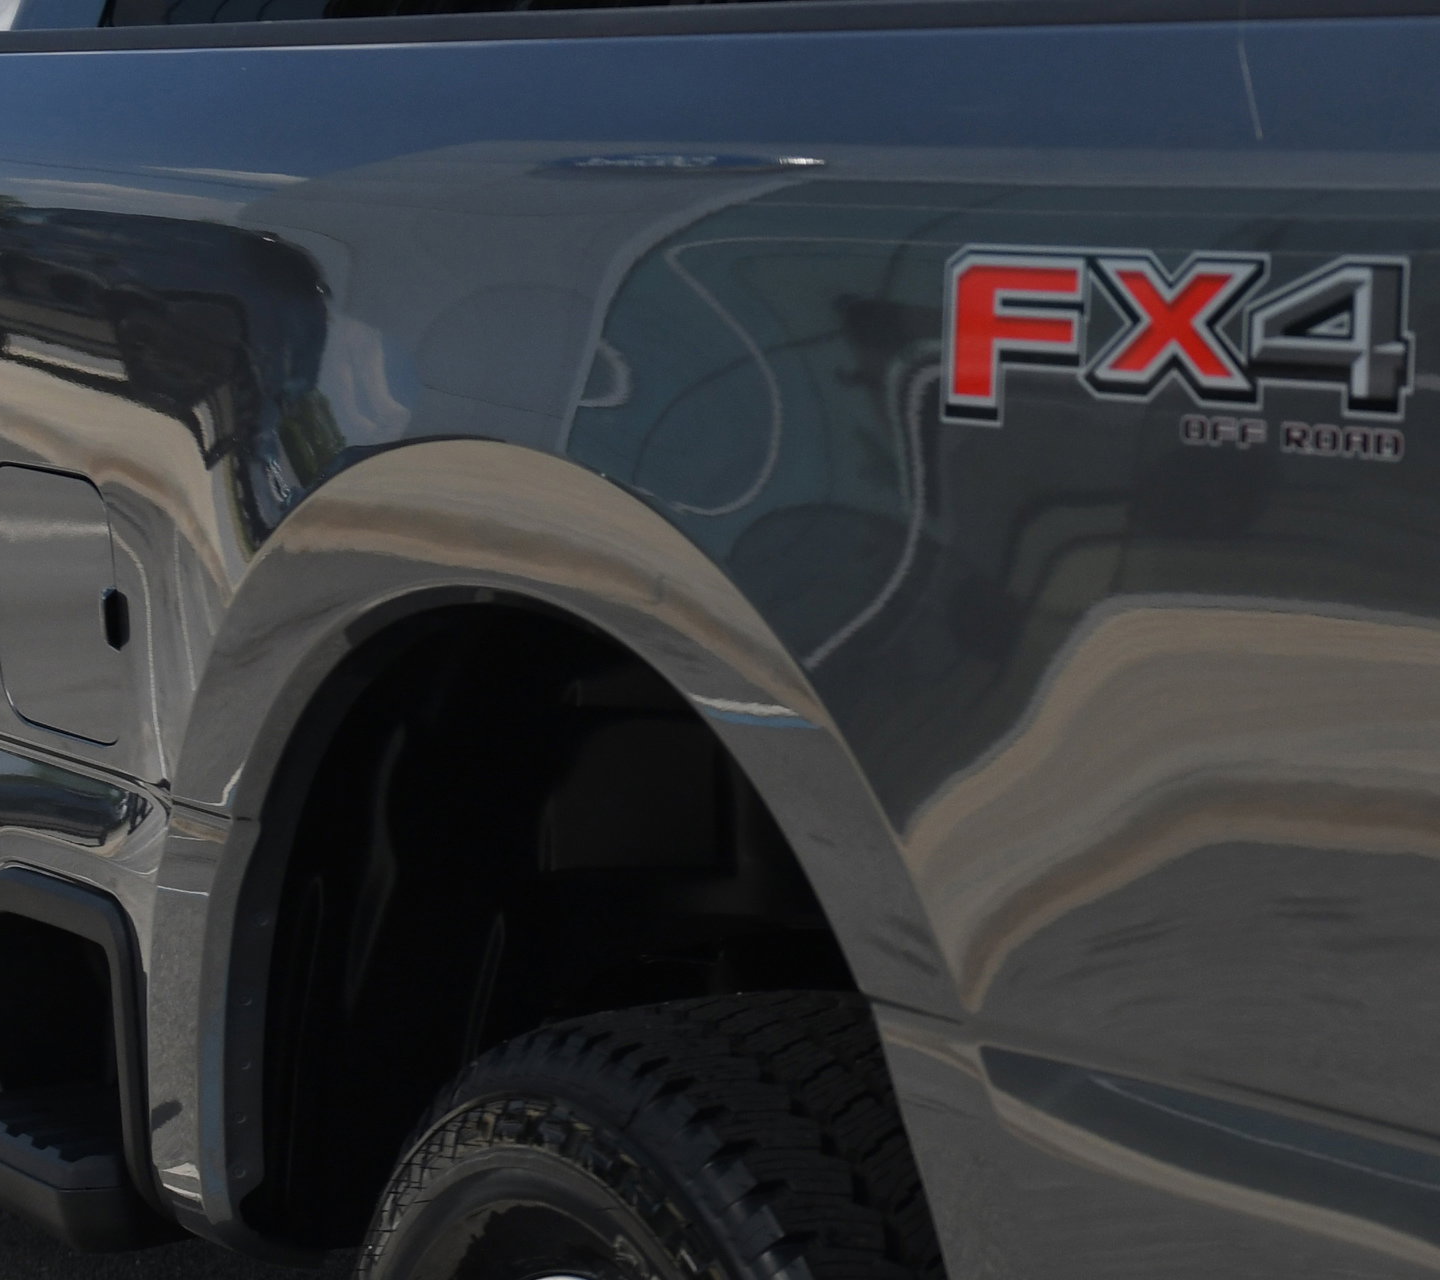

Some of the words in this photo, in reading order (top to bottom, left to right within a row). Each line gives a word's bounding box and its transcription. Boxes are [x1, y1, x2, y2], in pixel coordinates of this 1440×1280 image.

[941, 243, 1415, 426] FX4
[1180, 414, 1268, 451] OFF
[1281, 418, 1405, 463] ROAD
